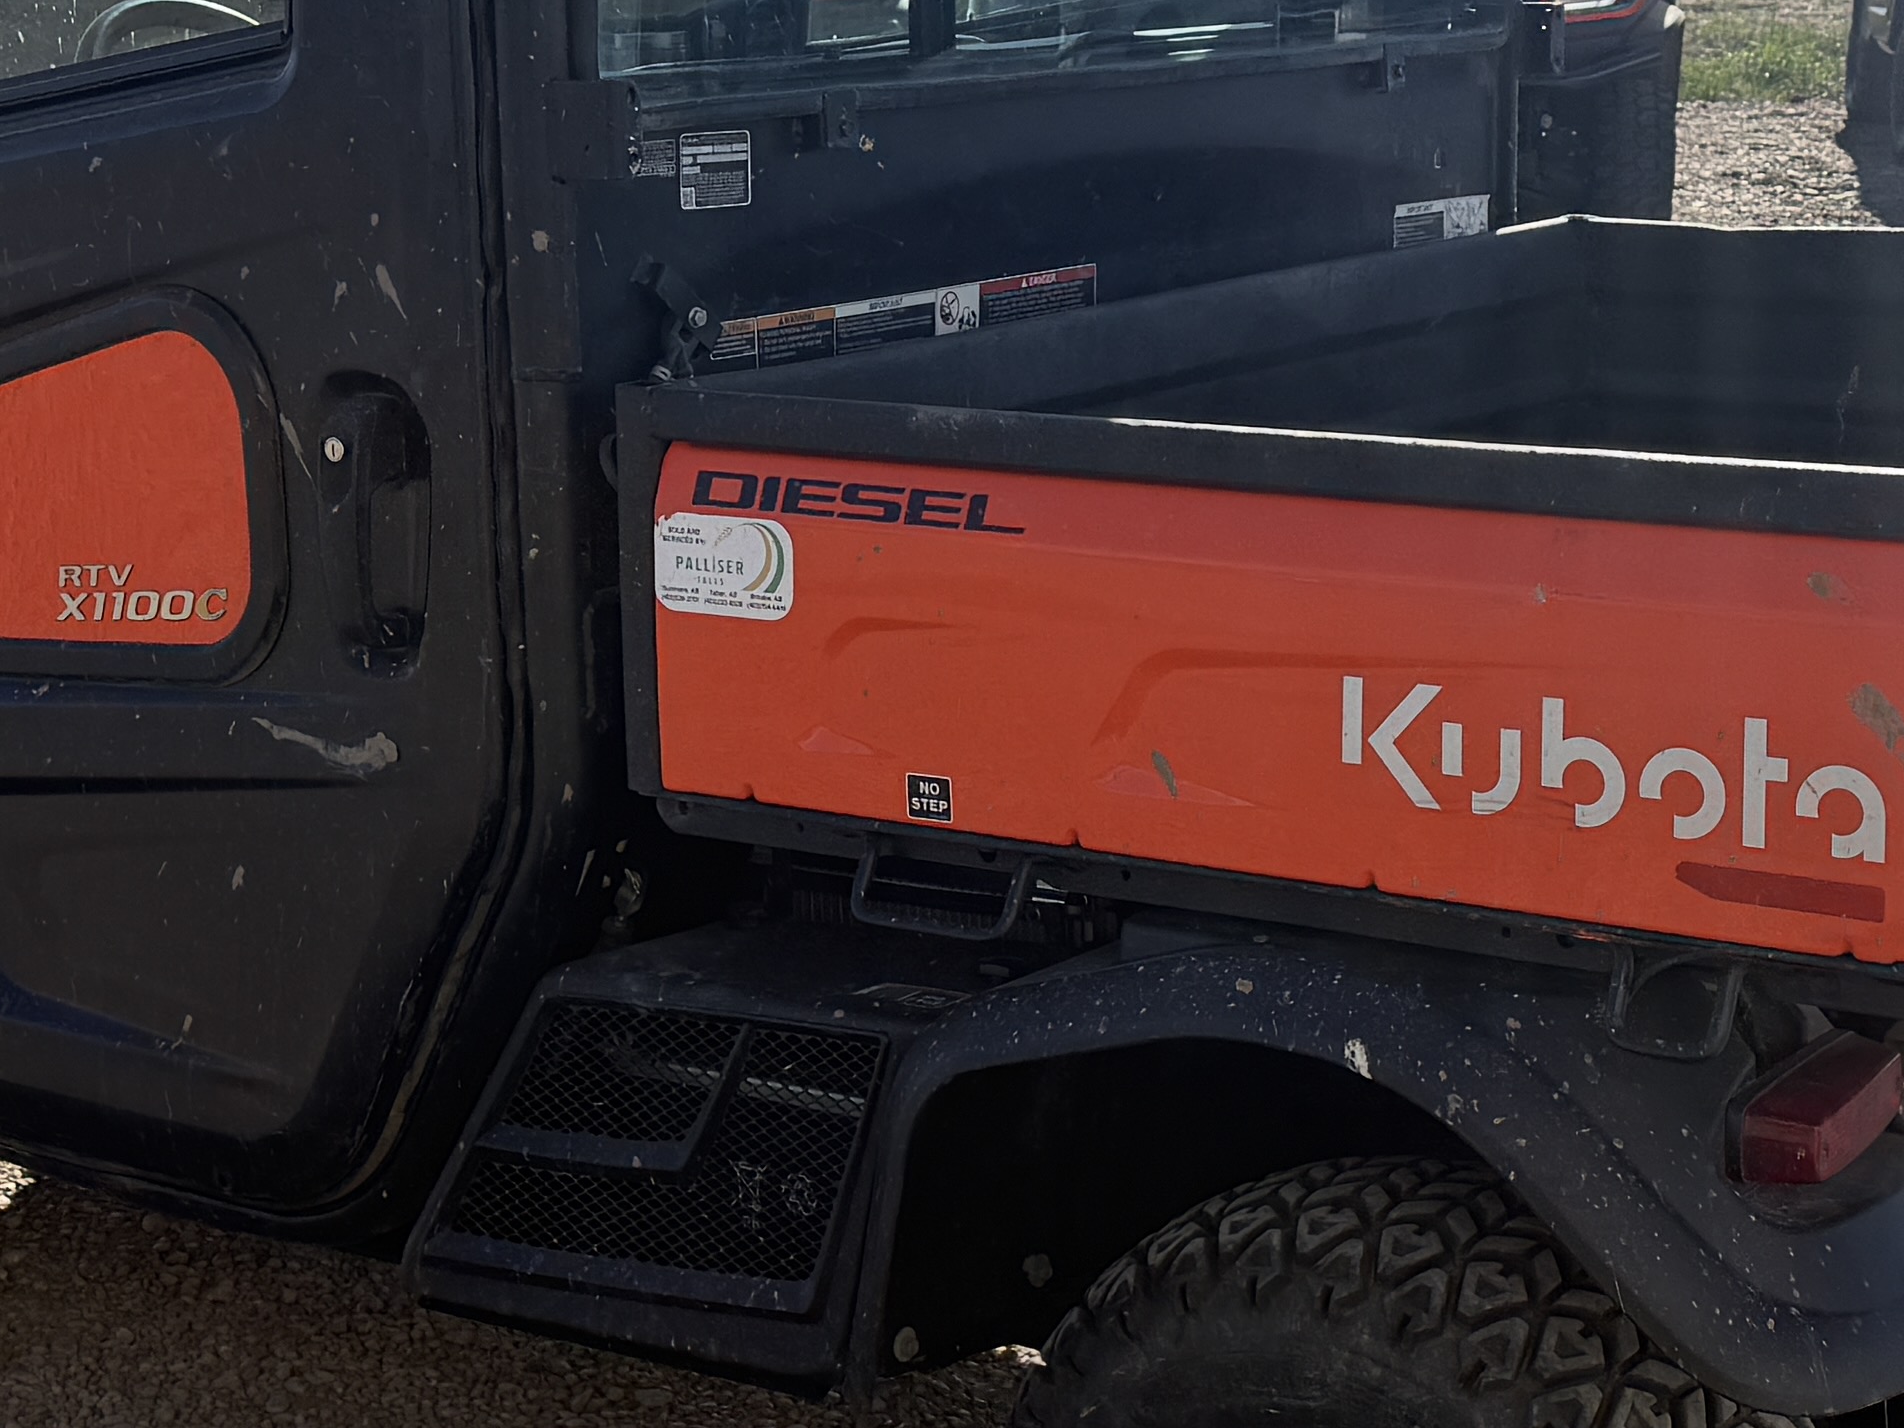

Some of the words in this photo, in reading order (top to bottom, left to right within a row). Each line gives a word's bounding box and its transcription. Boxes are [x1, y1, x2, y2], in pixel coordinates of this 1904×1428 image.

[691, 470, 1026, 535] DIESEL
[58, 563, 135, 588] RTV
[676, 554, 745, 576] PALLISER
[56, 588, 229, 622] X1100C
[1341, 674, 1887, 864] Kubota
[919, 781, 940, 795] NO
[911, 797, 948, 813] STEP
